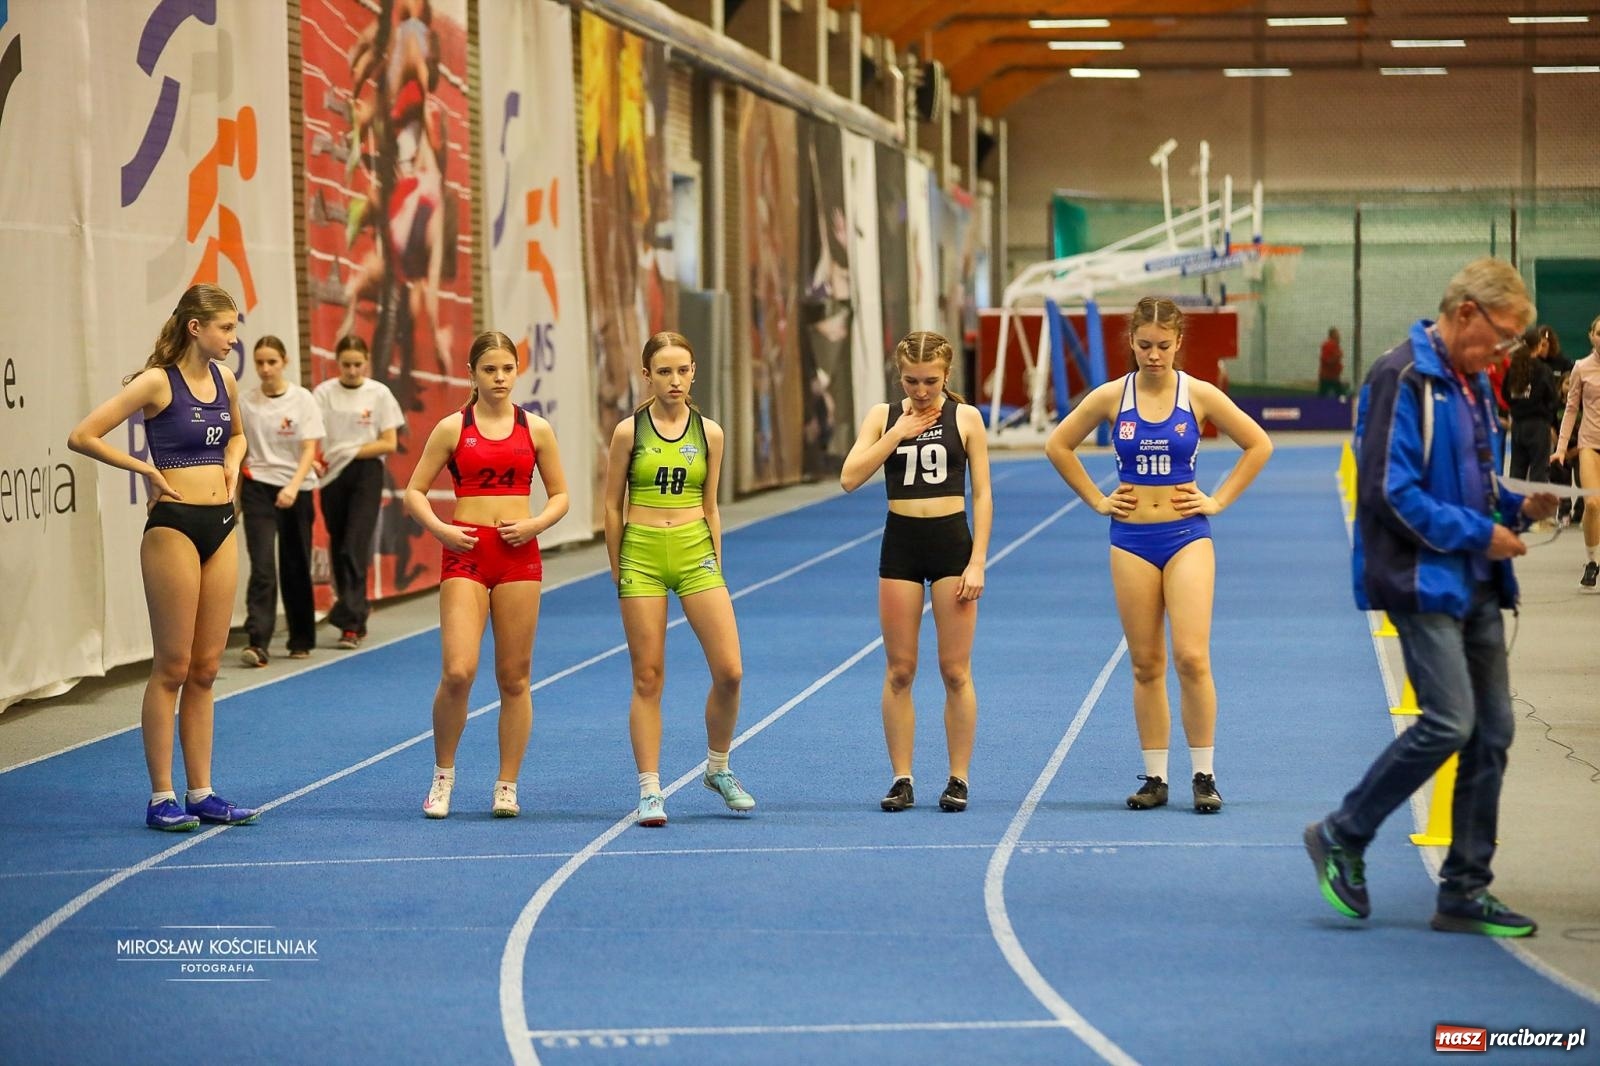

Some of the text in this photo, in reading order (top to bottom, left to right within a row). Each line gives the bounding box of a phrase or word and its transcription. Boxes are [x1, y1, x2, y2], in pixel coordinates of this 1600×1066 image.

[205, 426, 224, 446] 82
[896, 443, 948, 486] 79
[1135, 454, 1171, 475] 310
[478, 467, 516, 489] 24
[654, 466, 687, 495] 48
